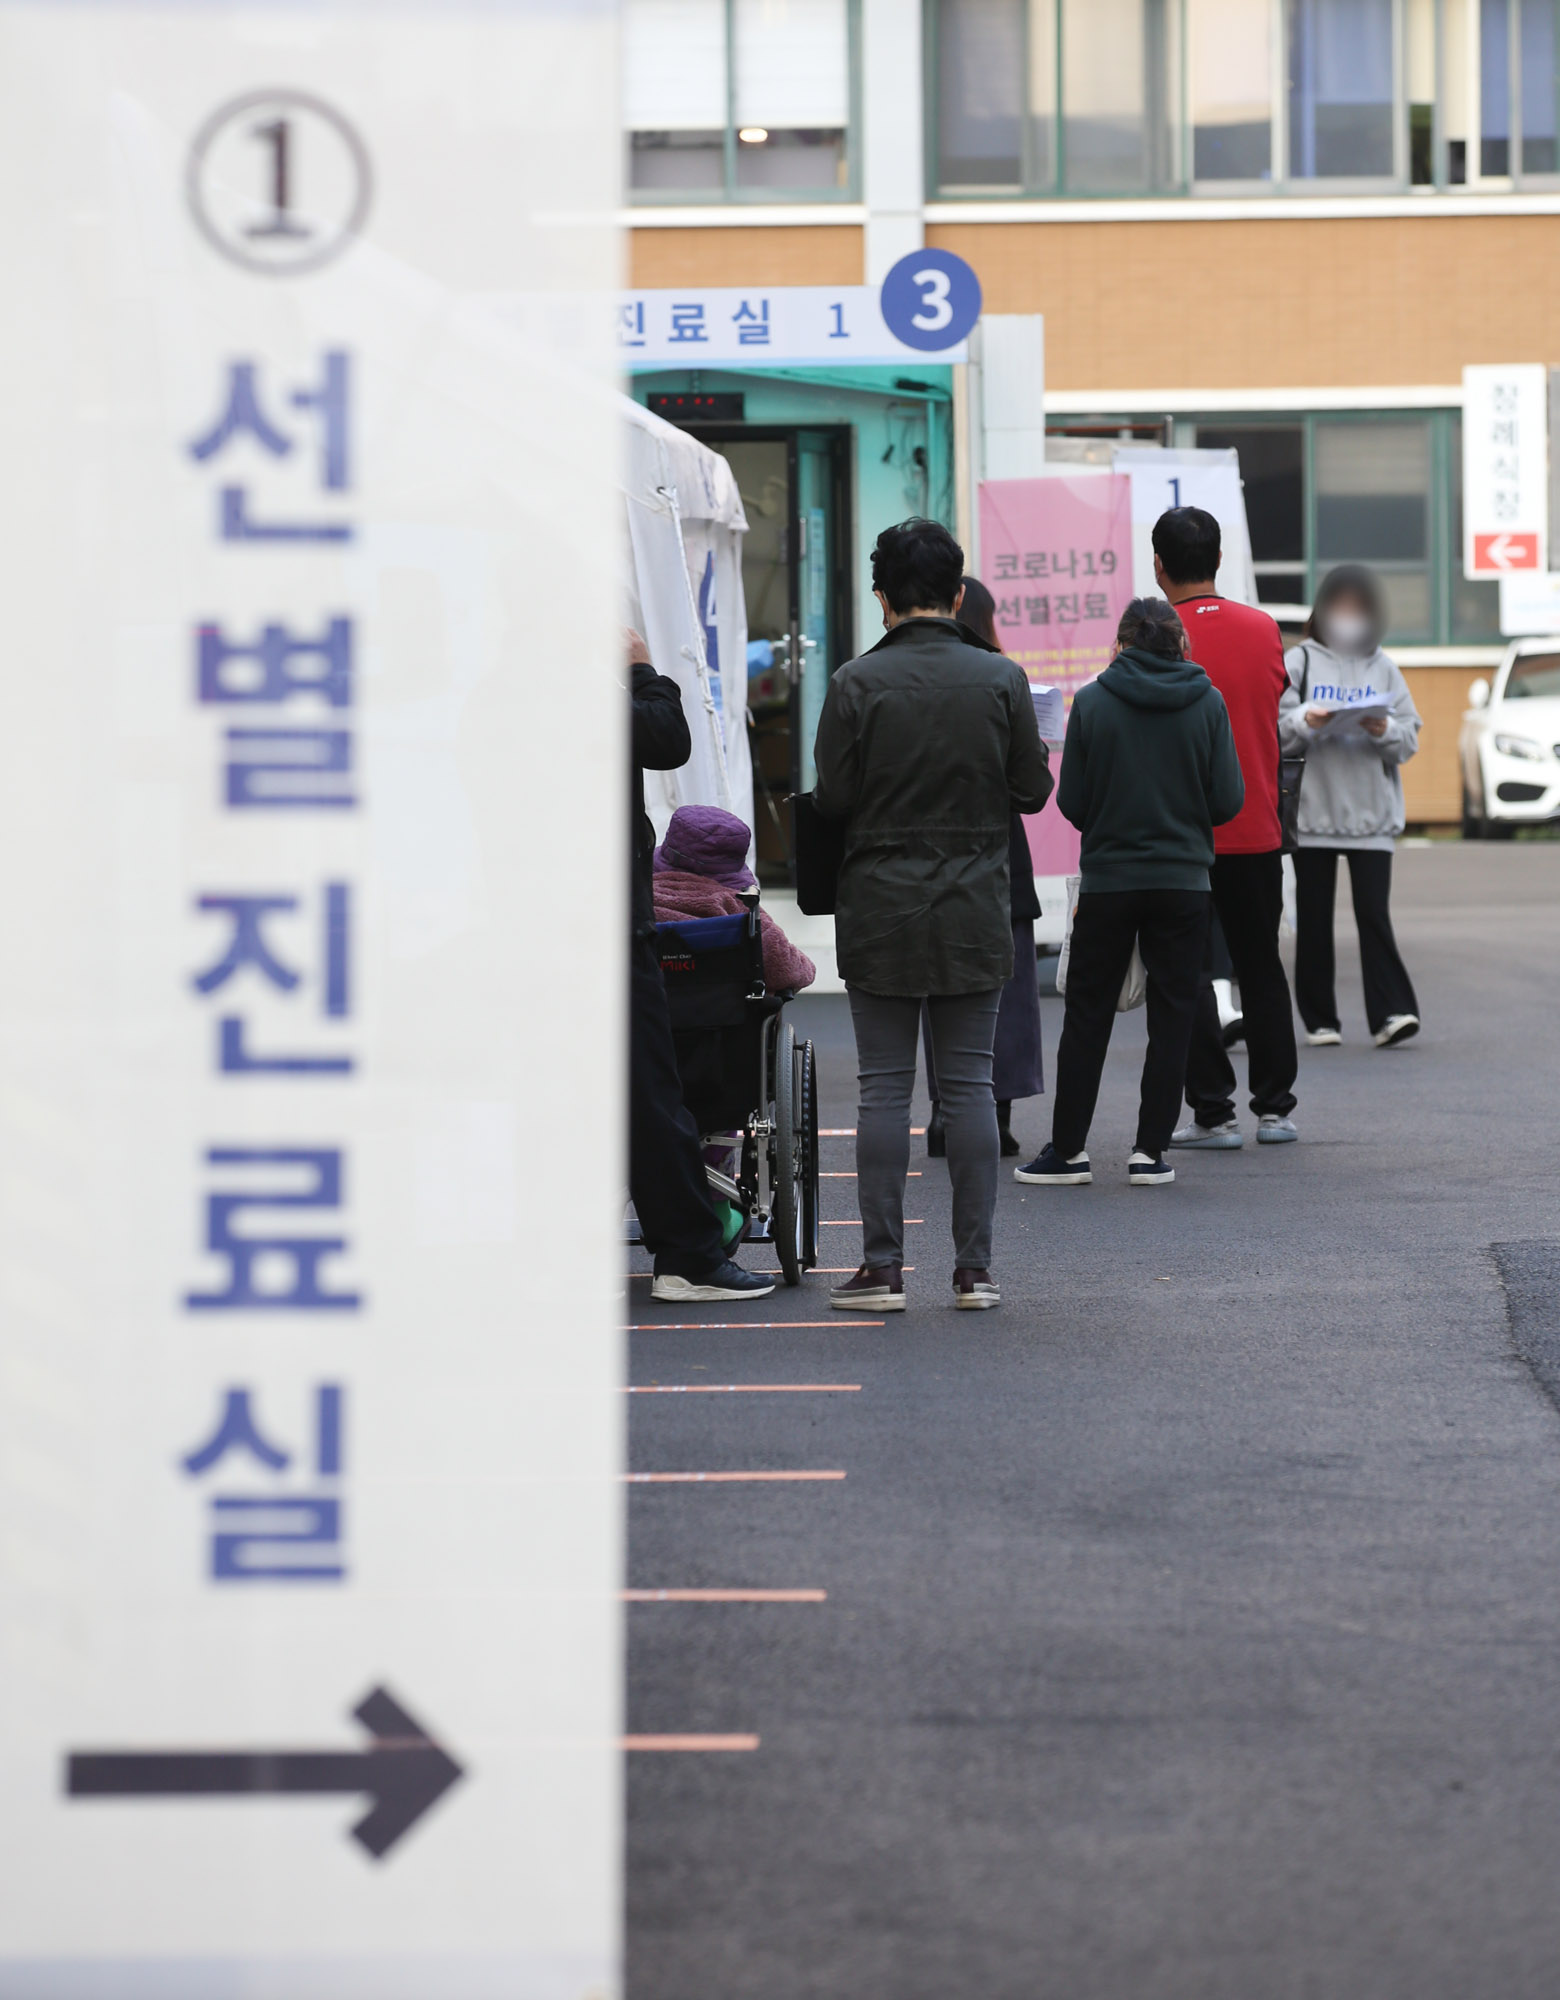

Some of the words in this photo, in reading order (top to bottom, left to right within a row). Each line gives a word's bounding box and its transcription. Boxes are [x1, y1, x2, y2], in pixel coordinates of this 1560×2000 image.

[911, 268, 954, 332] 3
[828, 303, 851, 339] 1
[993, 549, 1118, 581] 코로나19
[996, 592, 1111, 627] 선별진료
[183, 345, 363, 1583] 선별진료실
